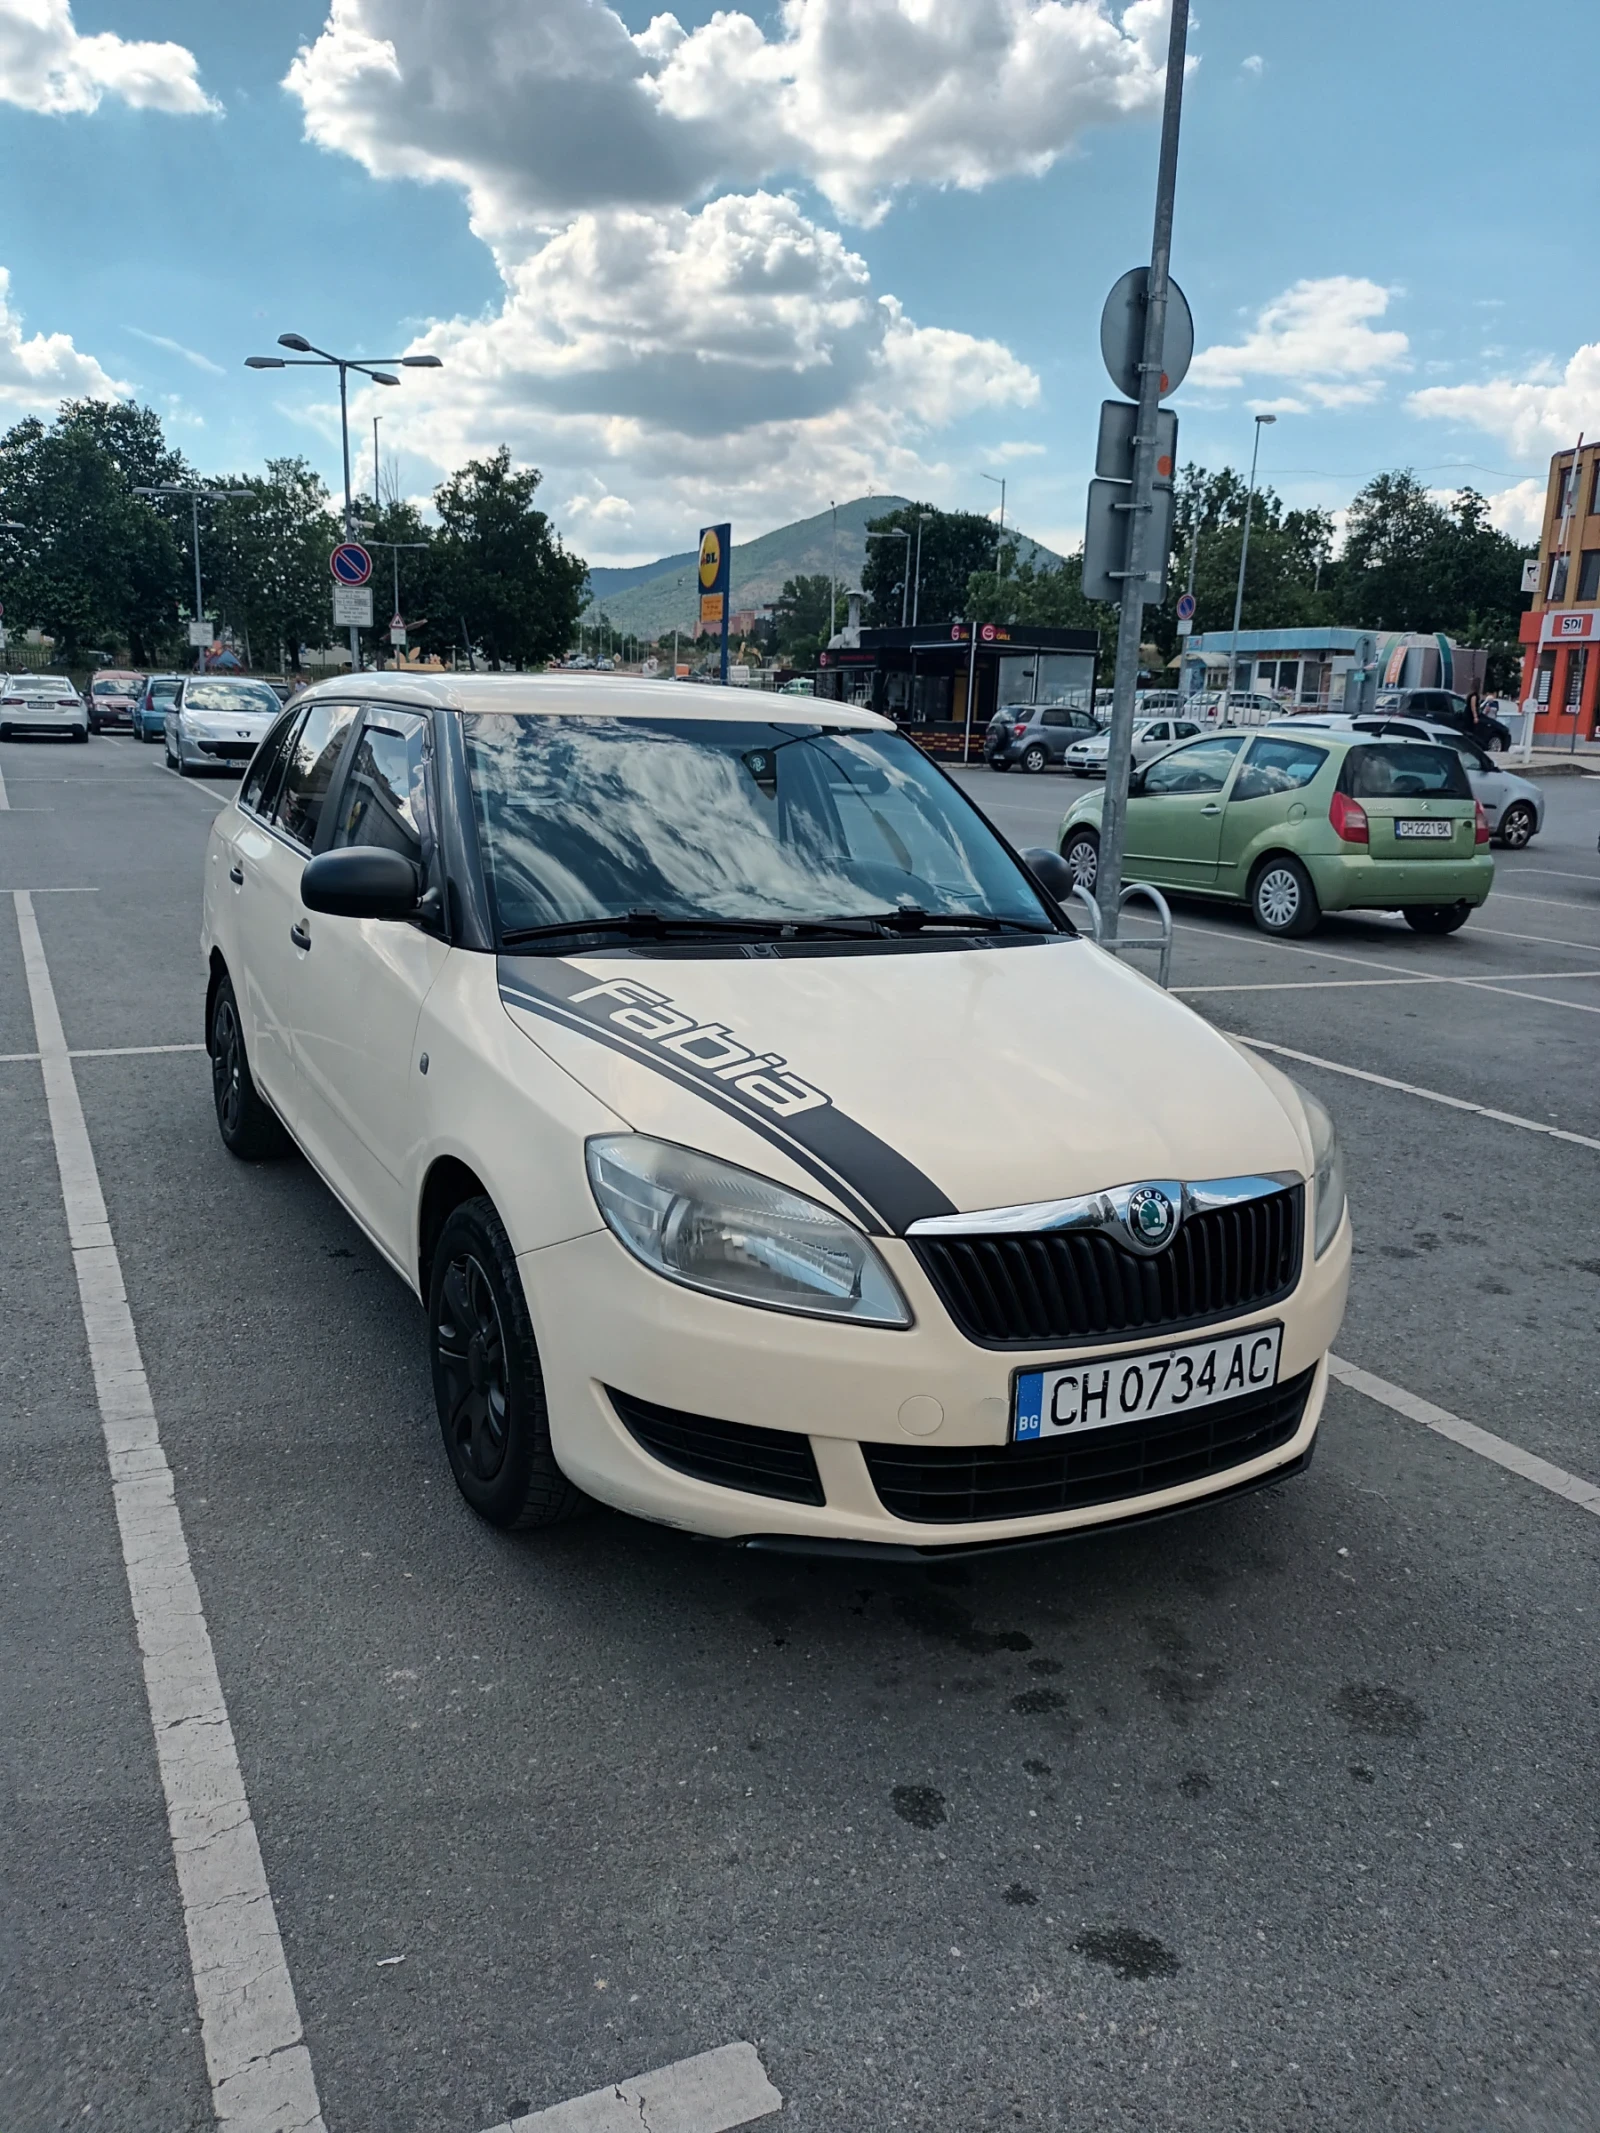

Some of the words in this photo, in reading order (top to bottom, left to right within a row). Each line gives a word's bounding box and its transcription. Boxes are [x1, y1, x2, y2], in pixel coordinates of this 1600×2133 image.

[1563, 618, 1582, 630] SDI
[1402, 823, 1414, 835] CH
[1415, 823, 1436, 835] 2221
[1438, 823, 1450, 835] BK
[566, 977, 833, 1118] Fabia
[1051, 1370, 1110, 1427] CH
[1119, 1349, 1217, 1413] 0734
[1224, 1337, 1273, 1391] AC
[1019, 1415, 1039, 1431] BG
